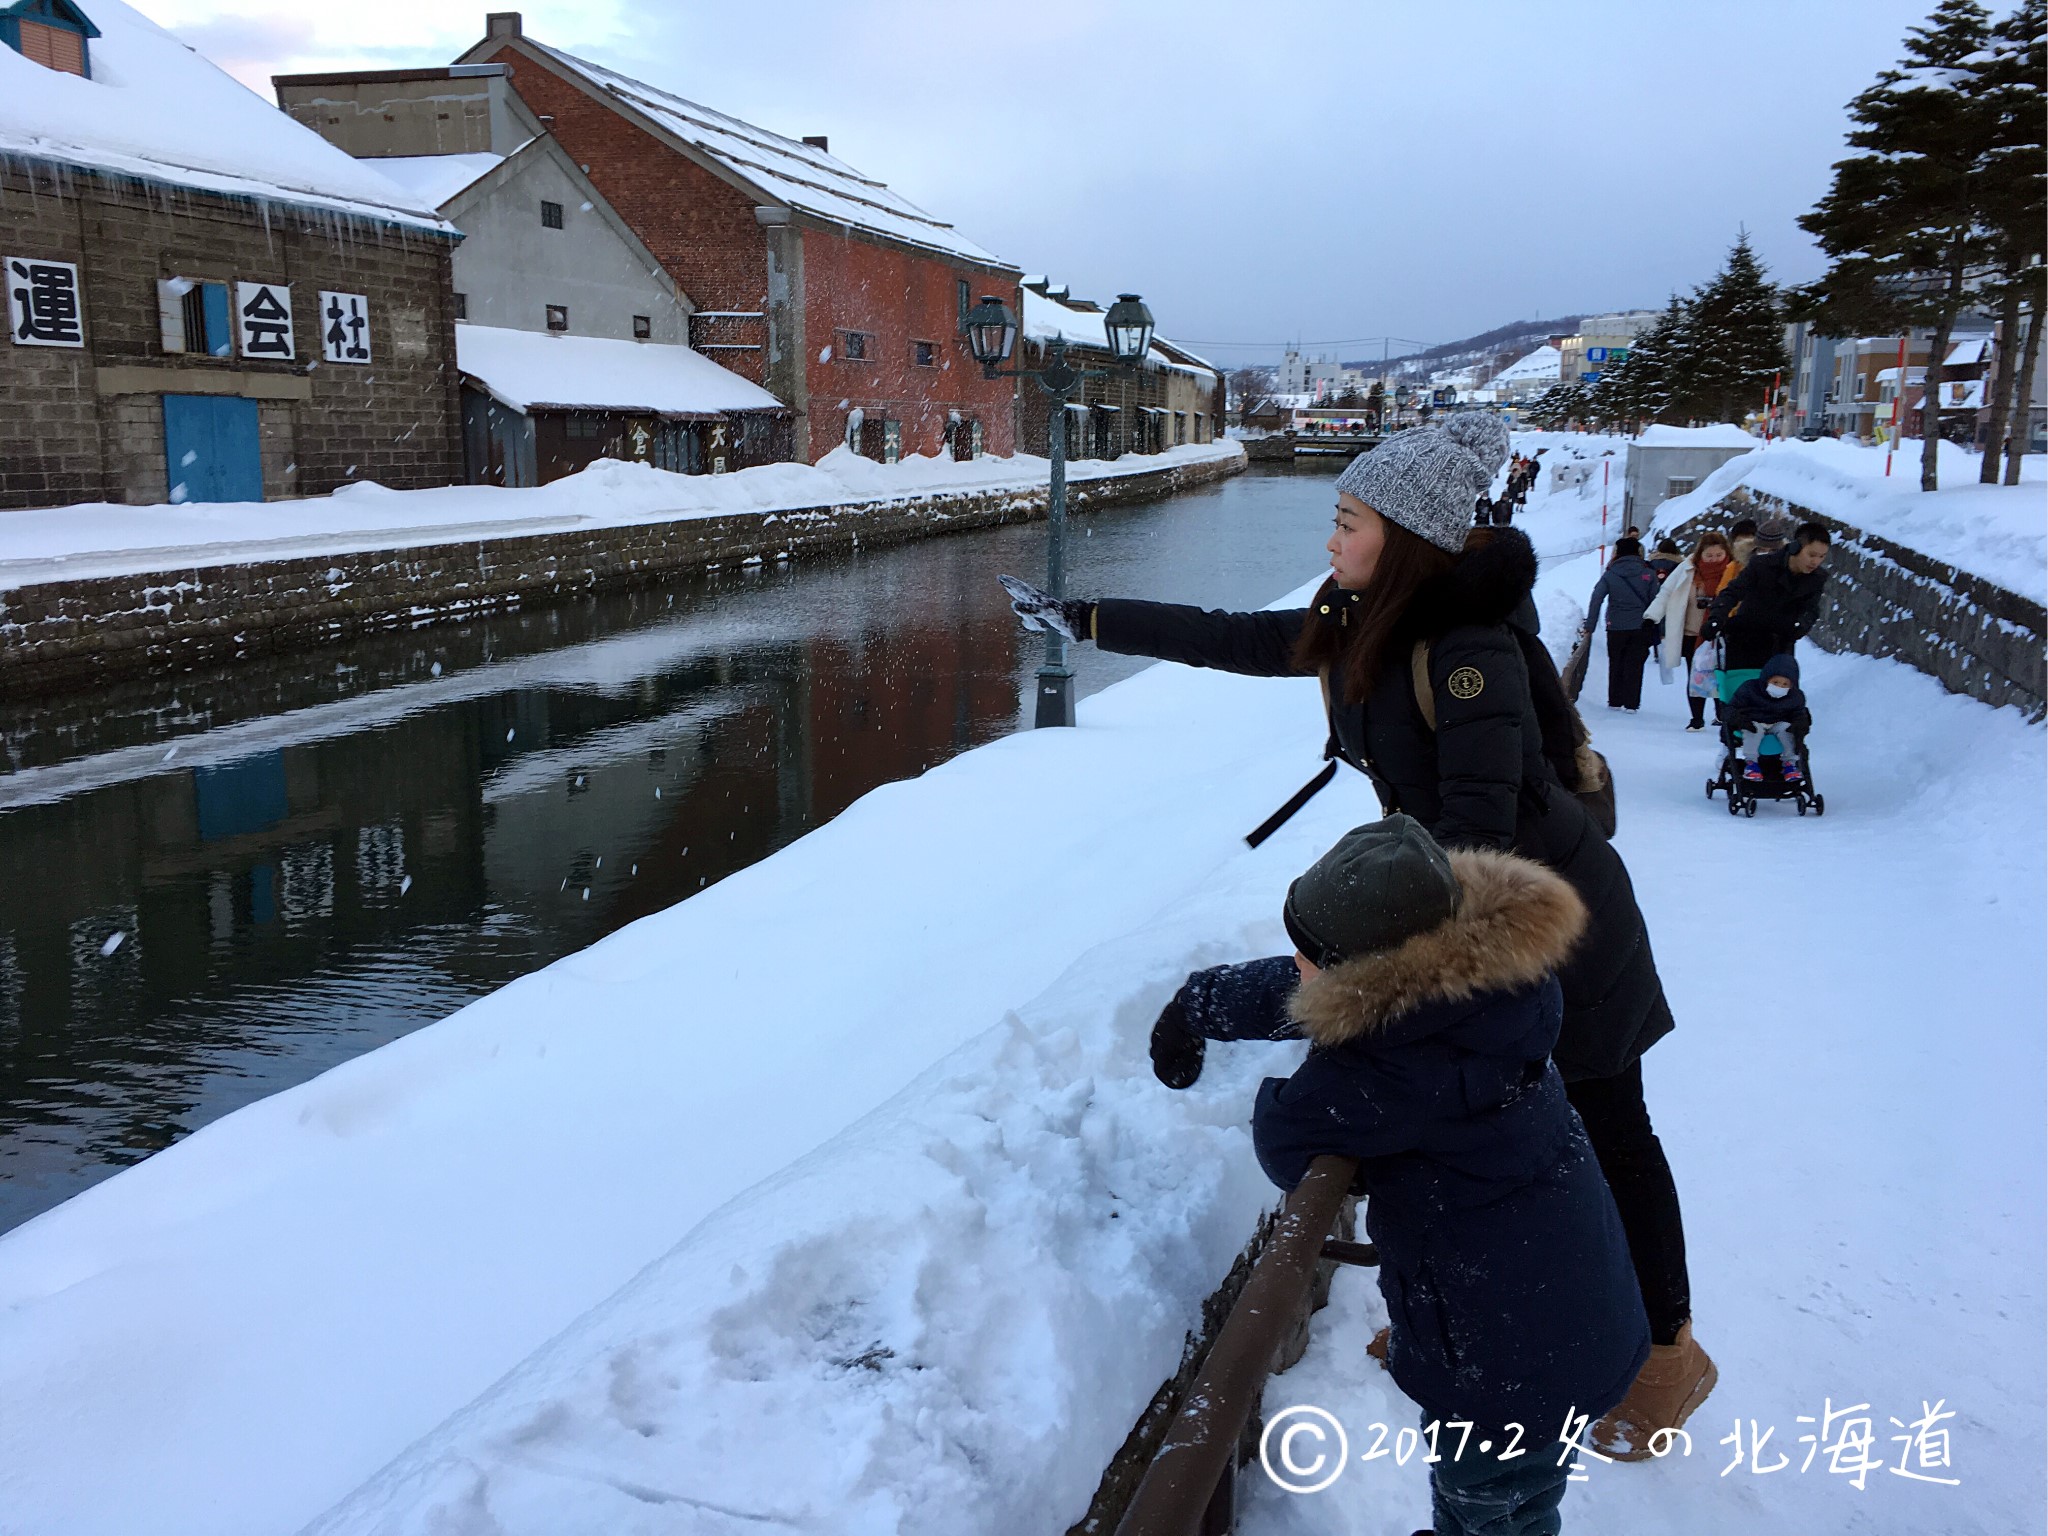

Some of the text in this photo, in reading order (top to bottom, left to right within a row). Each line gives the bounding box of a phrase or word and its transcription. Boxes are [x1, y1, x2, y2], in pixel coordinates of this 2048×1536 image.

[12, 261, 368, 359] 運 会 社
[632, 426, 650, 461] 倉
